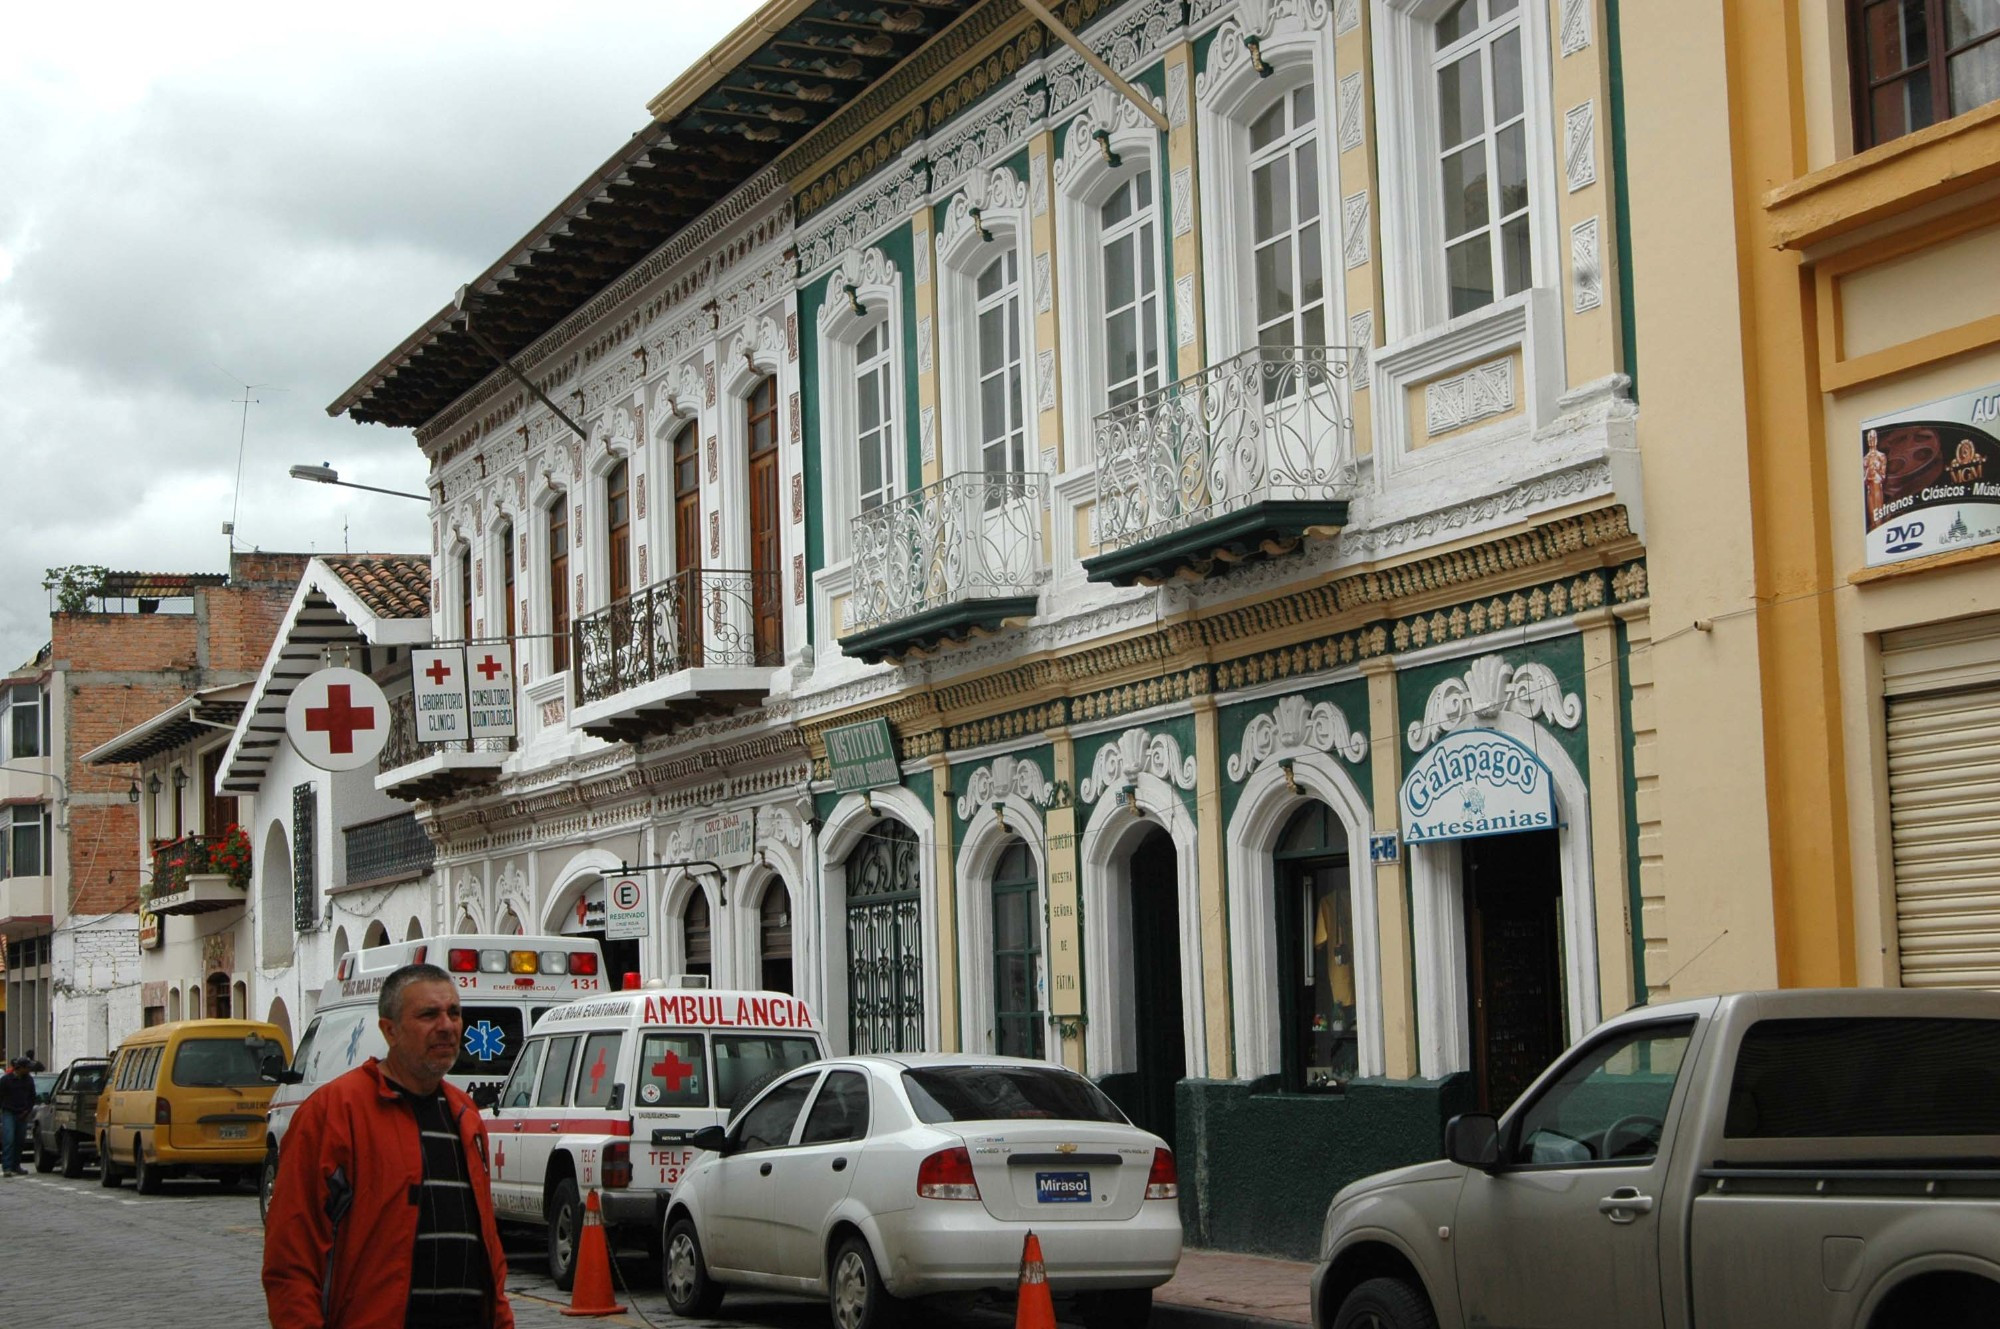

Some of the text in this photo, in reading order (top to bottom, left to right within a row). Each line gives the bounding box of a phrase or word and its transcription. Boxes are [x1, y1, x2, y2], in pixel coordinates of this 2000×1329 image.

[1971, 394, 2000, 425] AU
[1873, 495, 1914, 521] Estrenos
[1921, 484, 1965, 501] Clásicos
[1886, 521, 1924, 544] DVD
[418, 693, 463, 711] LABORATORIO
[472, 689, 511, 707] CONSULTORIO
[428, 714, 456, 731] CLINICO
[473, 709, 513, 727] ODONTOLOGICO
[830, 723, 884, 763] INSTITUTO
[1409, 749, 1534, 810] Galapagos
[705, 814, 740, 833] CRUZ ROJA
[1407, 809, 1548, 840] Artesanias
[1052, 871, 1072, 884] NUESTRA
[620, 887, 633, 904] E
[609, 911, 645, 920] RESERVADO
[1053, 903, 1073, 918] SEÑORA
[1060, 939, 1067, 951] DE
[342, 981, 356, 997] CRUZ
[356, 978, 372, 995] ROJA
[570, 978, 598, 990] 131
[1056, 972, 1074, 990] FÁTIMA
[548, 1002, 631, 1021] CRUZ ROJA ECUATORIANA
[643, 996, 812, 1028] AMBULANCIA
[583, 1167, 593, 1183] 131
[1040, 1179, 1088, 1191] Mirasol
